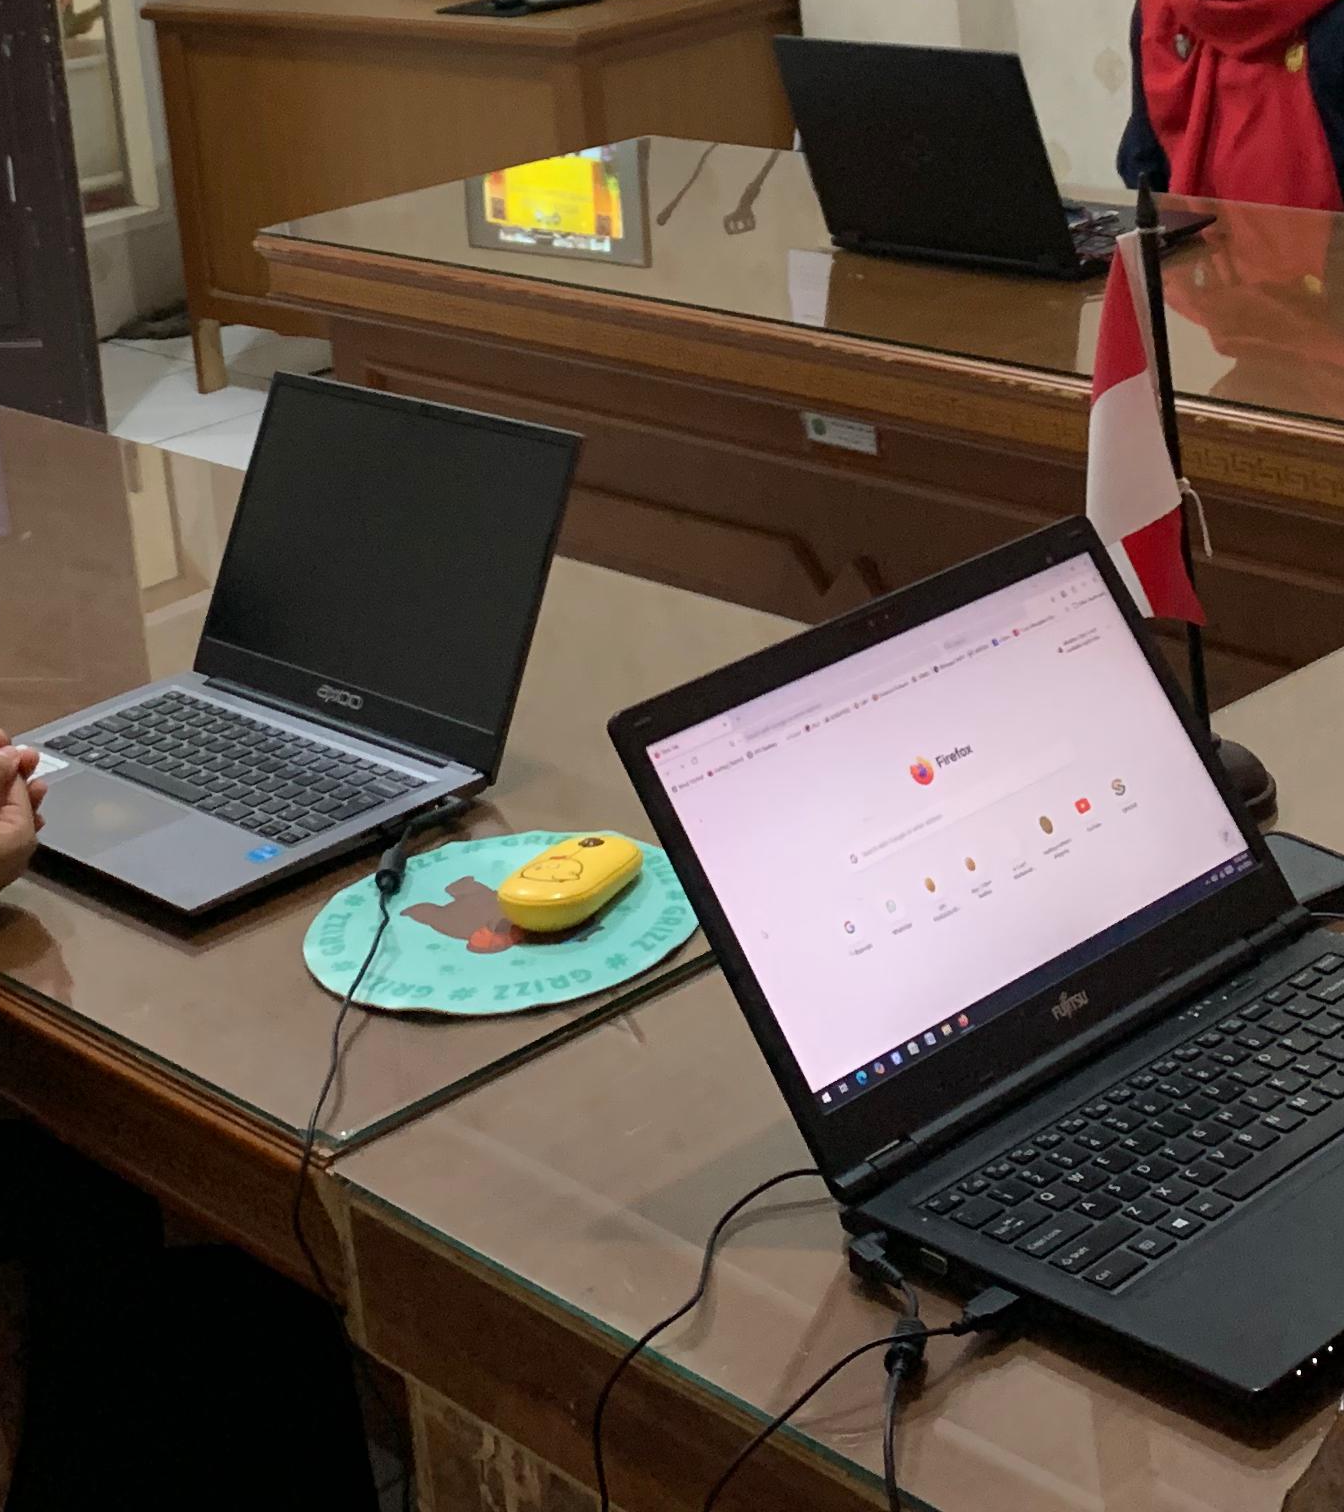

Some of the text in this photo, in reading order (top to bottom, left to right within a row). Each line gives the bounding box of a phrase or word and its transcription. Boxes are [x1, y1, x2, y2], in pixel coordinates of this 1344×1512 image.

[935, 744, 973, 768] Firefox
[629, 906, 687, 951] GRIZZ
[493, 968, 593, 1000] GRIZZ
[1051, 990, 1089, 1021] FUJITSU
